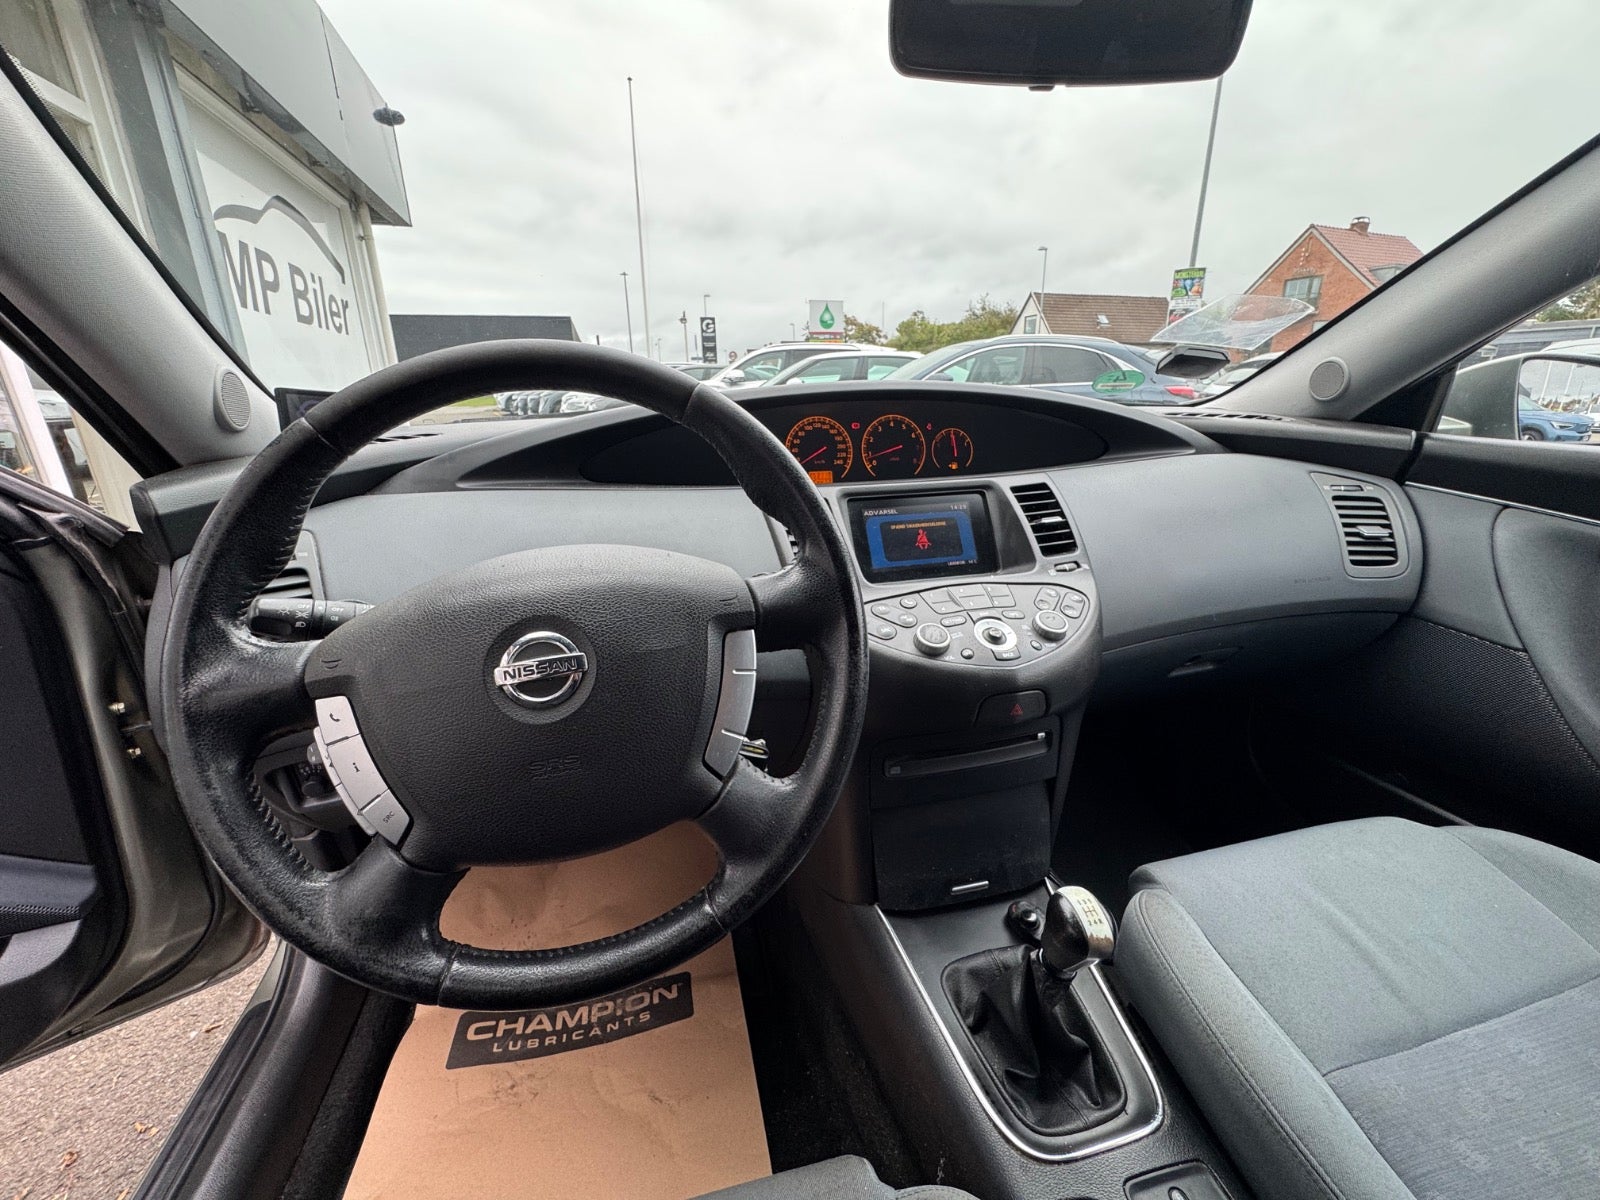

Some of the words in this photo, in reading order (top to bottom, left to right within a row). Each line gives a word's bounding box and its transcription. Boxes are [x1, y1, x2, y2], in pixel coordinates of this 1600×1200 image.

[216, 230, 280, 315] MP
[288, 262, 349, 335] Biler
[863, 508, 898, 517] ADVARSEL
[503, 658, 577, 681] NISSAN
[382, 811, 395, 824] SRC
[466, 984, 679, 1041] CHAMPION
[492, 1011, 651, 1053] LUBRICANTS
